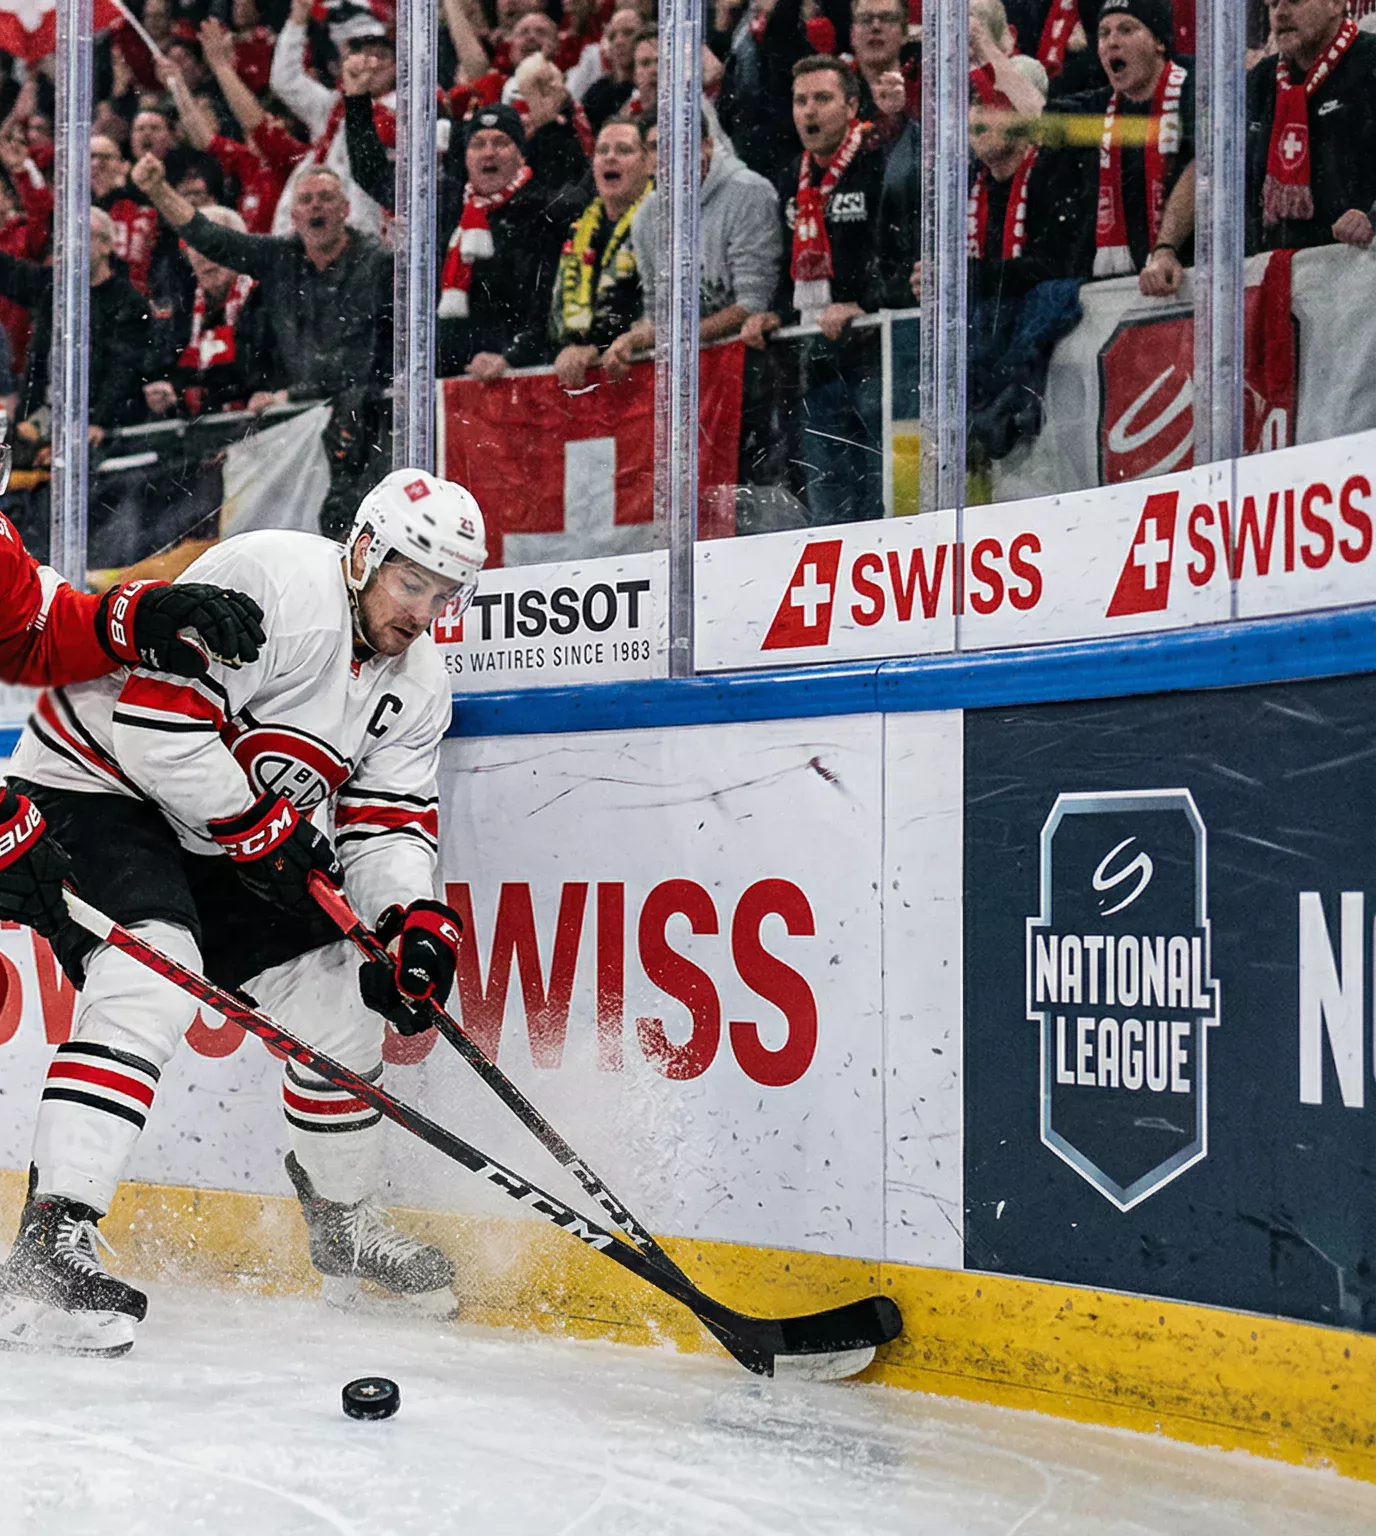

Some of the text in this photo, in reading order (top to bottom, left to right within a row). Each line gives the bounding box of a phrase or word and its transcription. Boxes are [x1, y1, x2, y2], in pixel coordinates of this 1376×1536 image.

[1186, 475, 1373, 588] SWISS
[472, 580, 651, 641] TISSOT
[851, 532, 1043, 627] SWISS
[470, 648, 545, 672] WATIRES
[553, 643, 604, 668] SINCE
[367, 692, 403, 739] C
[382, 877, 819, 1087] WISS
[1036, 934, 1211, 1009] NATIONAL
[1299, 891, 1376, 1108] N
[1056, 1015, 1191, 1093] LEAGUE
